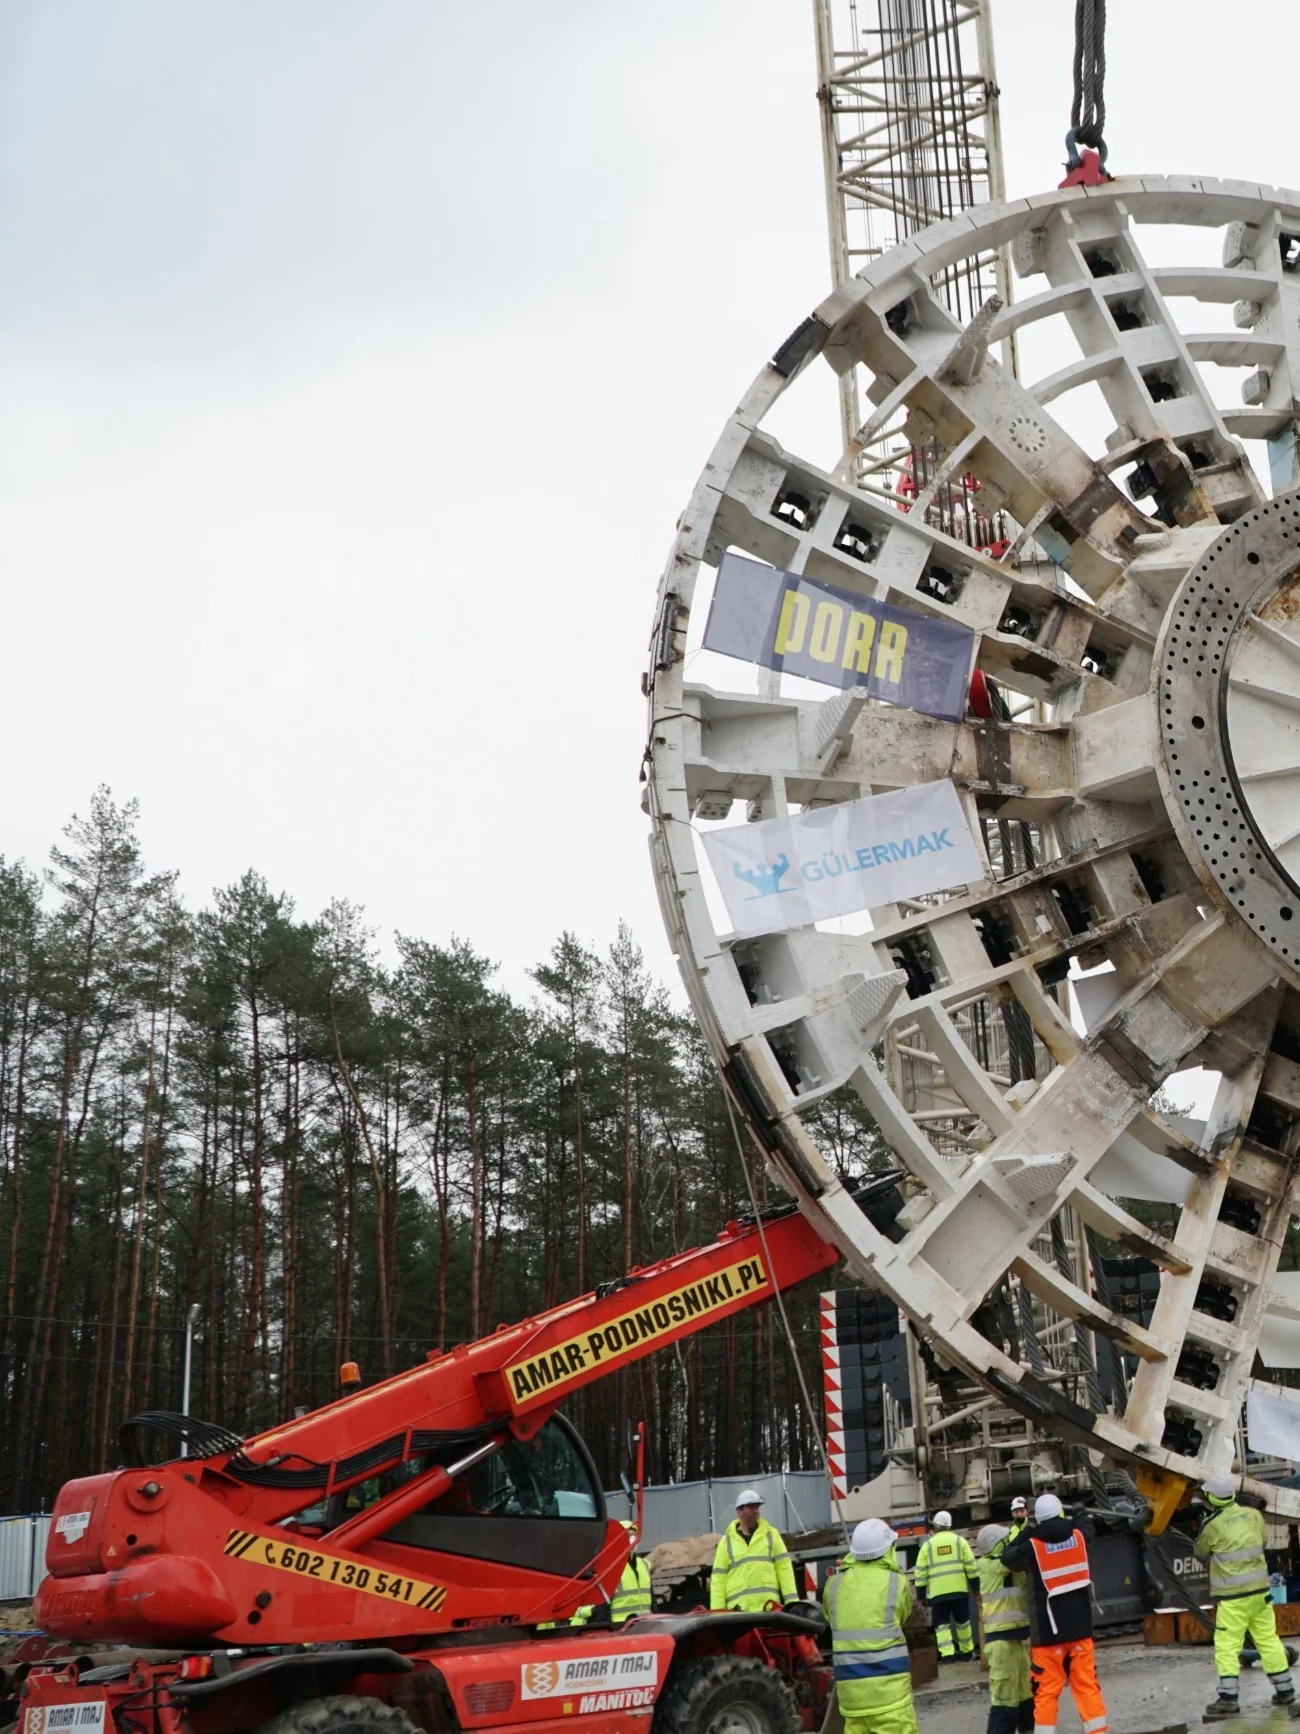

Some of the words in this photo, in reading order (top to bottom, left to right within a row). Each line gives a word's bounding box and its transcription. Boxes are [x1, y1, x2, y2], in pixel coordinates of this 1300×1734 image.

[800, 828, 955, 882] GÜLERMAK
[511, 1260, 767, 1399] AMAR-PODNOSNIKI.PL
[281, 1548, 324, 1576] 602
[330, 1561, 370, 1588] 130
[374, 1574, 414, 1601] 541
[1173, 1557, 1207, 1576] DEM
[565, 1659, 609, 1680] AMAR
[612, 1658, 617, 1675] I
[620, 1655, 653, 1674] MAJ
[47, 1707, 75, 1727] AMAR
[80, 1704, 104, 1725] MAJ
